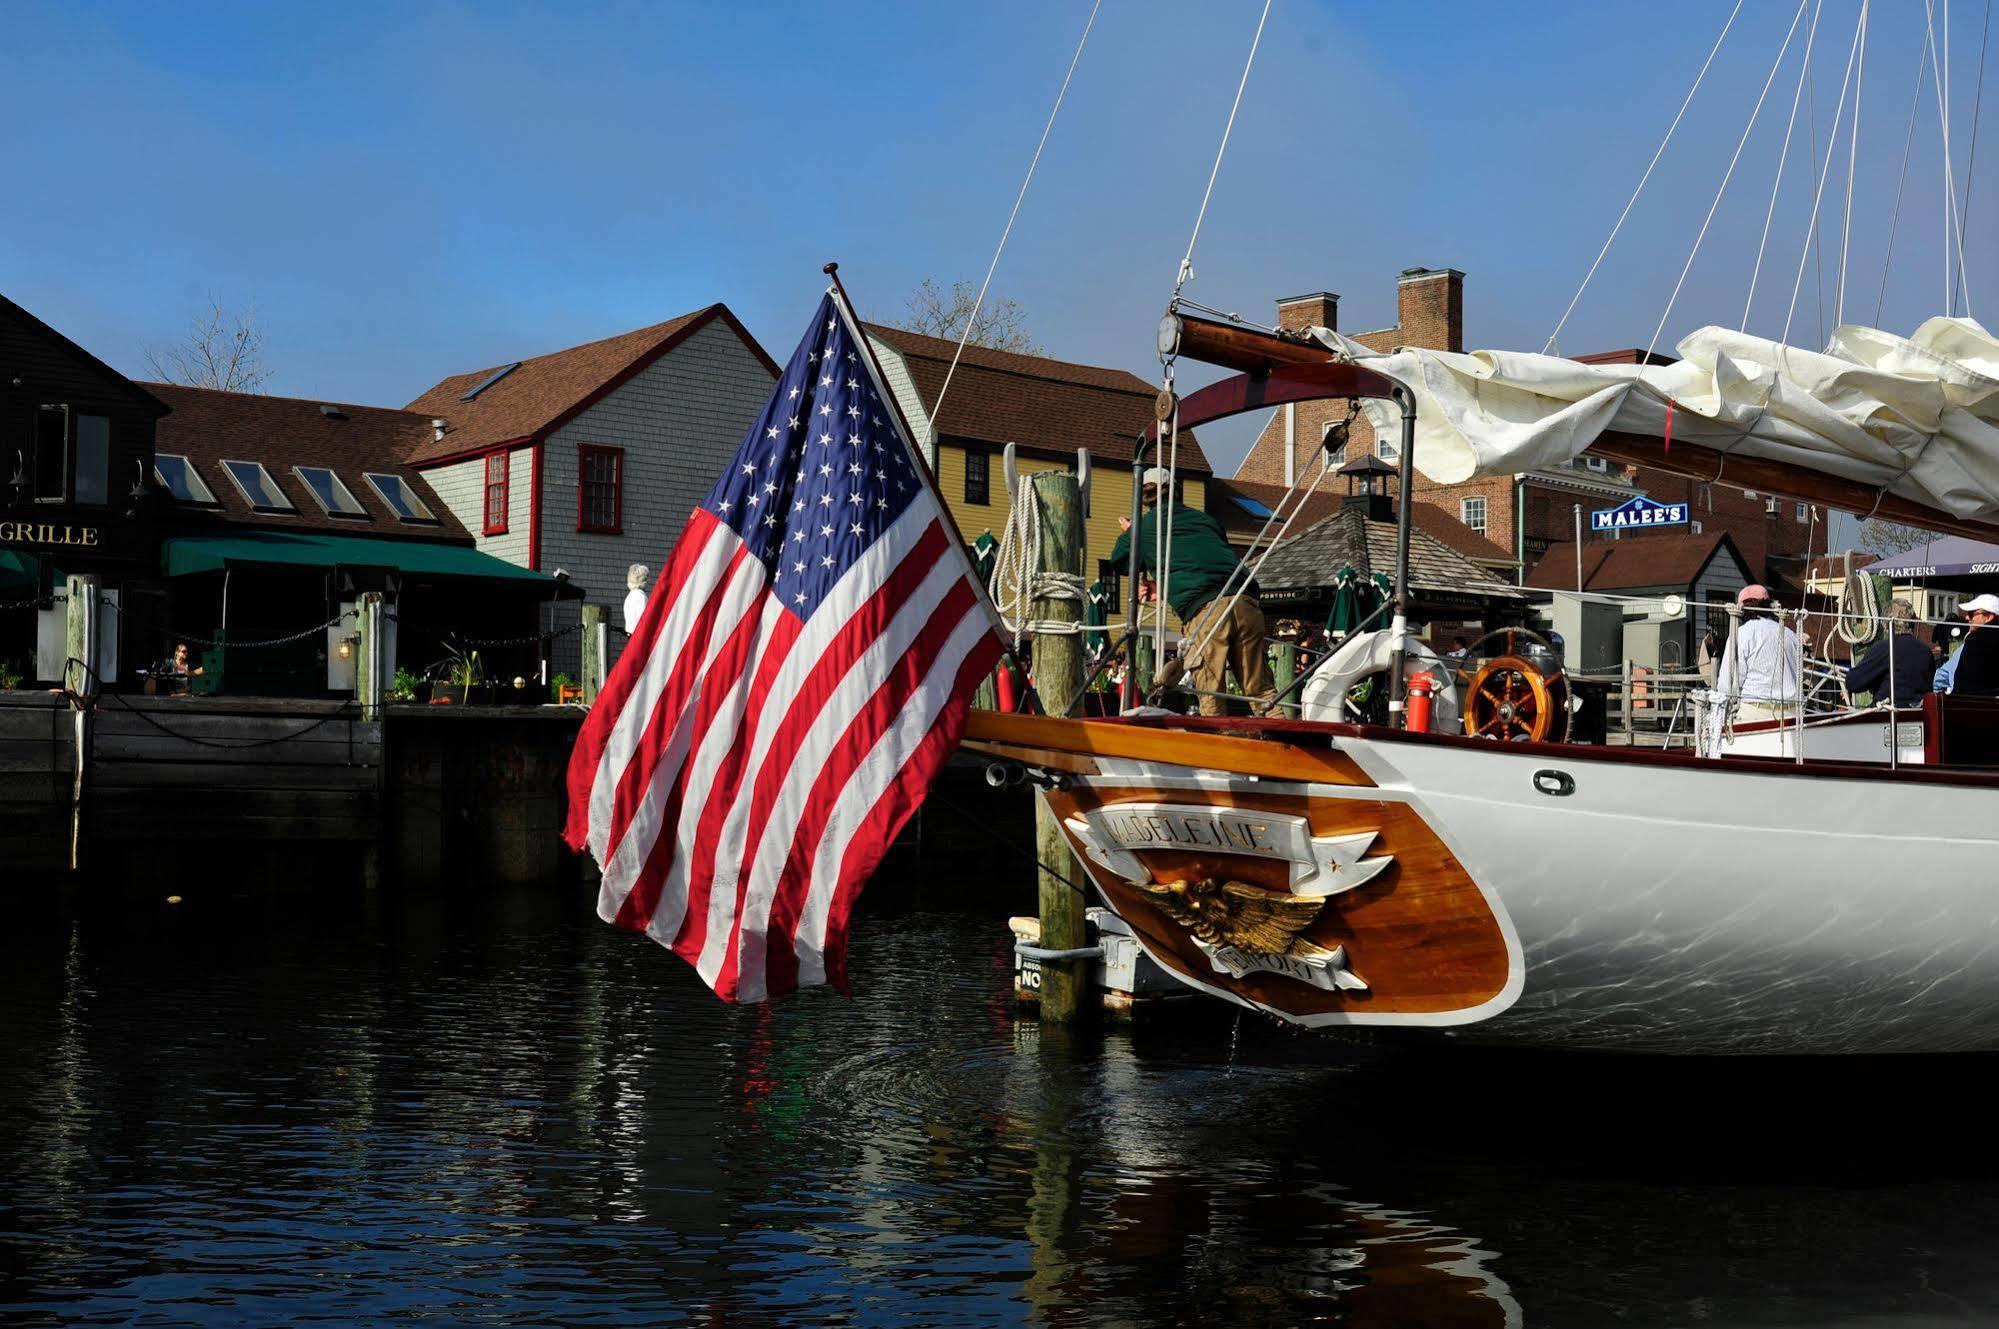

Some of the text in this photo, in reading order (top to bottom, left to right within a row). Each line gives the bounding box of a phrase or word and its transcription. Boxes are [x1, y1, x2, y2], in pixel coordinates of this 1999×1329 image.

[1598, 507, 1681, 527] MALEE'S
[0, 522, 98, 546] GRILLE
[1879, 566, 1937, 578] CHARTERS
[1102, 815, 1272, 852] MADELEINE
[1022, 970, 1041, 988] NO
